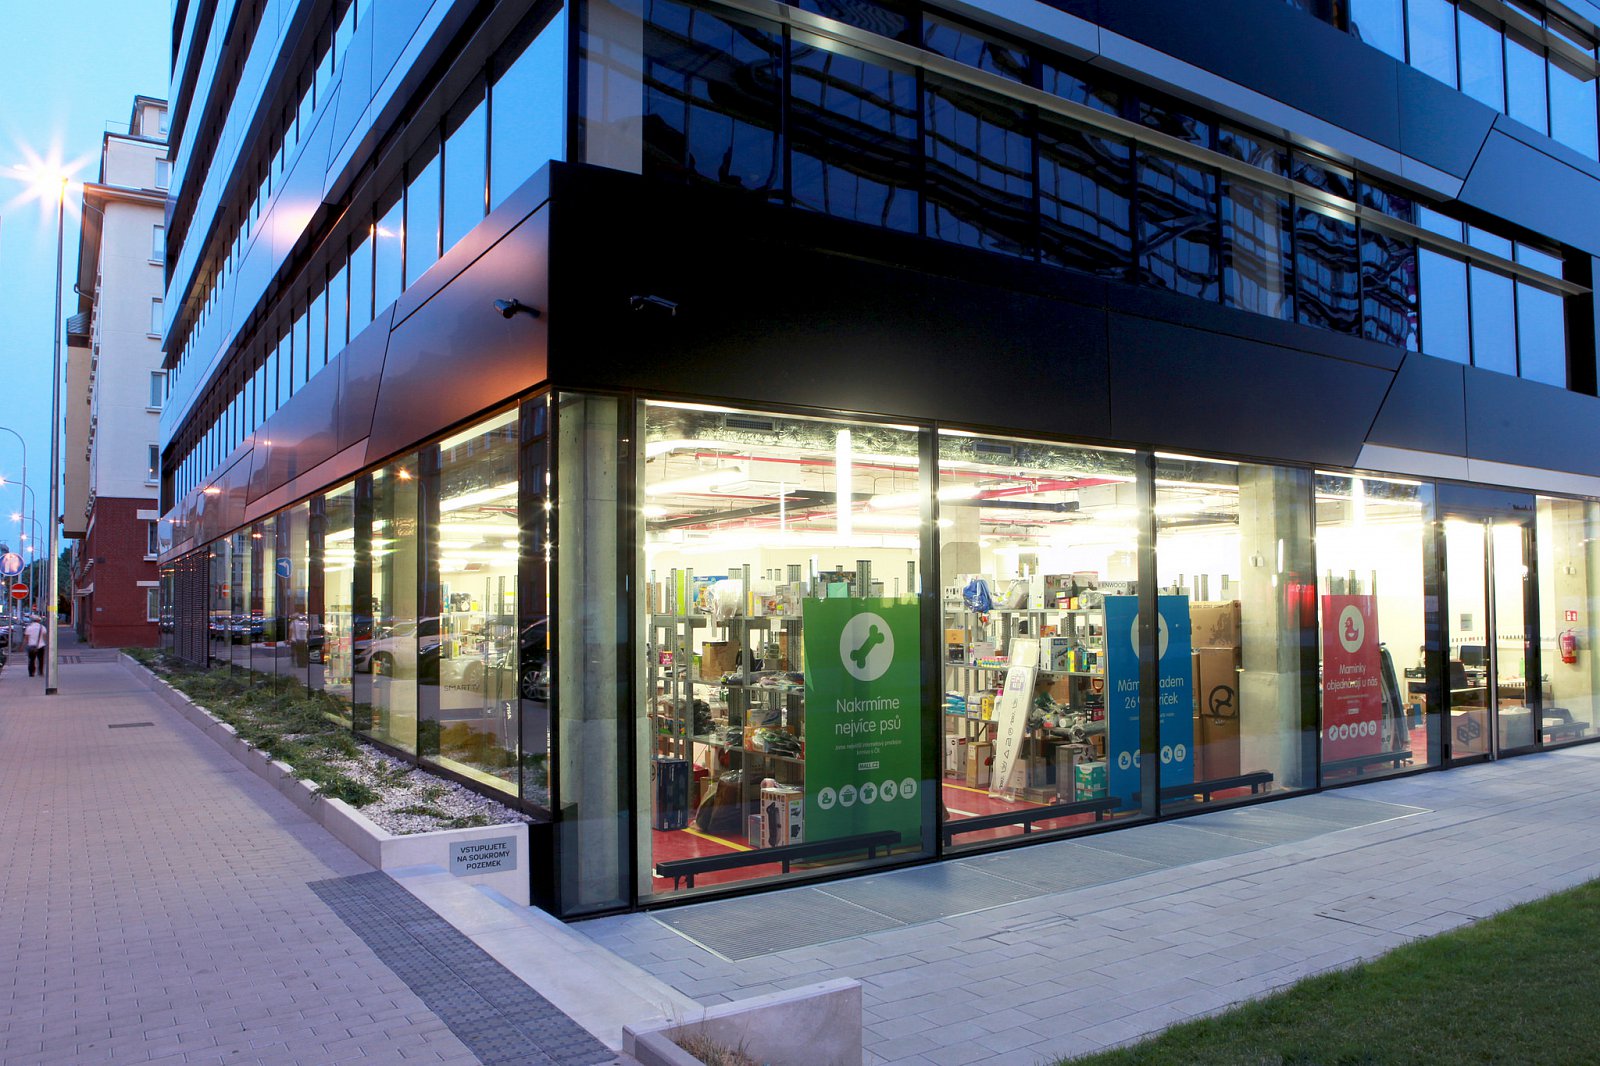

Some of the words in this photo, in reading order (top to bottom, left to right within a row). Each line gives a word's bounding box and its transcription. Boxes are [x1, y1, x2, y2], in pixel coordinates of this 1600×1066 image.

[1339, 663, 1366, 675] Maminky
[1367, 676, 1378, 687] nás
[444, 684, 470, 692] SMART
[836, 696, 900, 713] Nakrmíme
[1125, 696, 1136, 709] 26
[835, 718, 876, 737] nejvíce
[880, 714, 901, 735] psů
[460, 842, 507, 854] VSTUPUJETE
[457, 855, 467, 863] NA
[466, 860, 501, 870] POZEMEK
